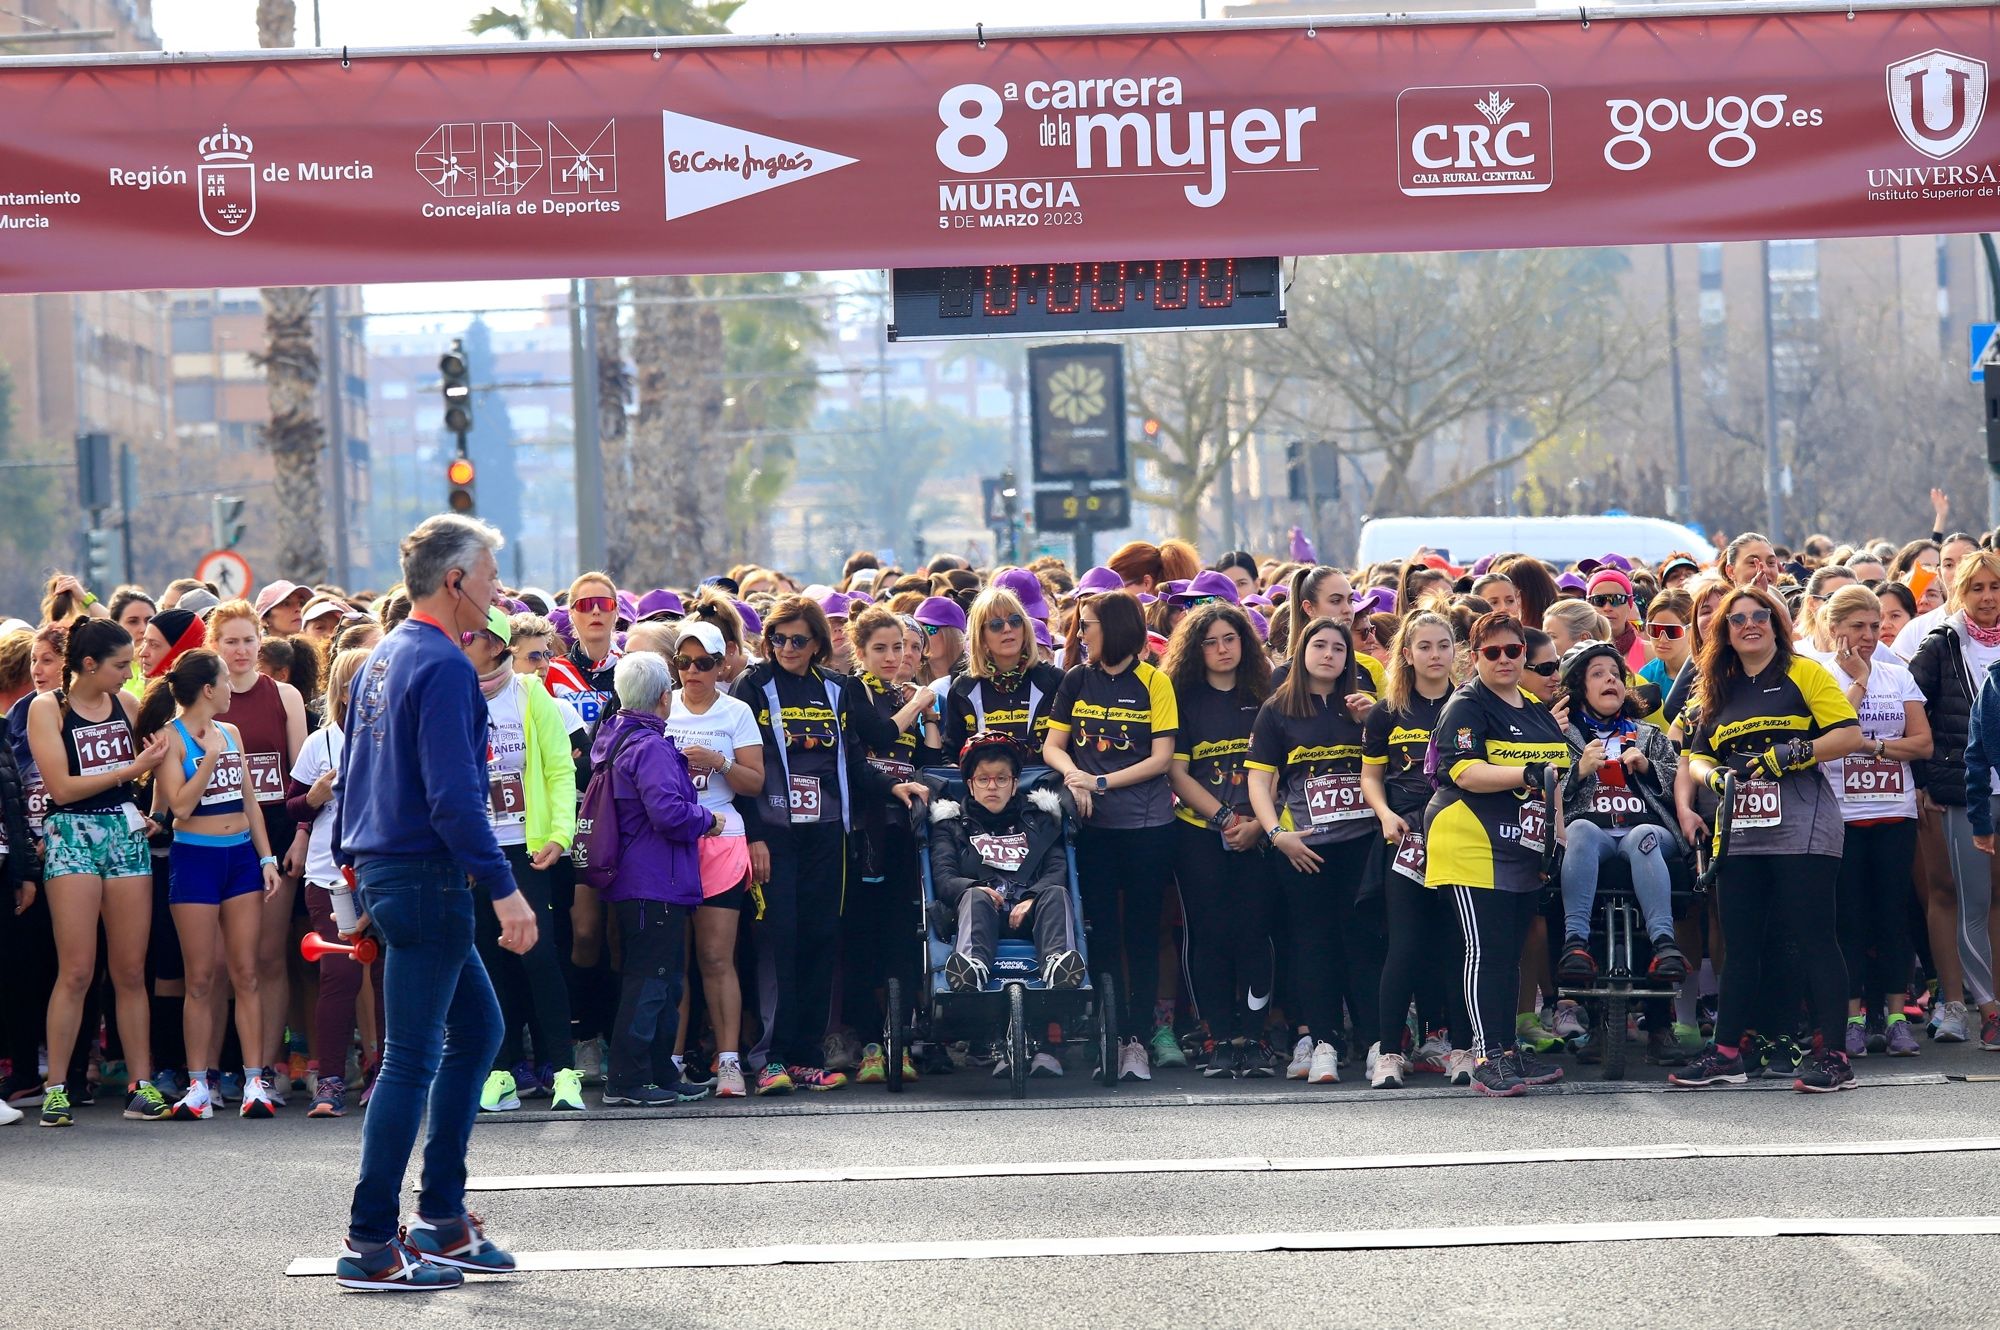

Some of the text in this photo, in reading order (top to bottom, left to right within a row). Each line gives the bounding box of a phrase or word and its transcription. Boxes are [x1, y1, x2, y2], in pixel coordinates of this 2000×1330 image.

[1025, 76, 1183, 110] carrera
[1411, 122, 1535, 169] CRC
[668, 150, 690, 173] El
[691, 150, 740, 173] Corte
[1040, 107, 1317, 208] de la mujer
[109, 160, 374, 190] Región de Murcia
[1413, 171, 1536, 184] CAJA RURAL CENTRAL
[1867, 164, 2000, 187] UNIVERSA
[939, 181, 1080, 211] MURCIA
[1868, 186, 1994, 201] Instituto Superior de
[422, 199, 621, 219] Concejalía de Deportes
[940, 211, 1083, 229] 5 DE MARZO 2023
[81, 735, 132, 762] 1611
[1490, 749, 1541, 760] ZANCADAS
[1541, 750, 1565, 759] SOBRE
[250, 767, 280, 787] 74
[793, 777, 816, 785] MURCIA
[1845, 771, 1900, 790] 4971
[790, 790, 817, 809] 83
[1311, 787, 1364, 809] 4797
[1733, 793, 1777, 814] 790
[1521, 815, 1546, 836] 47
